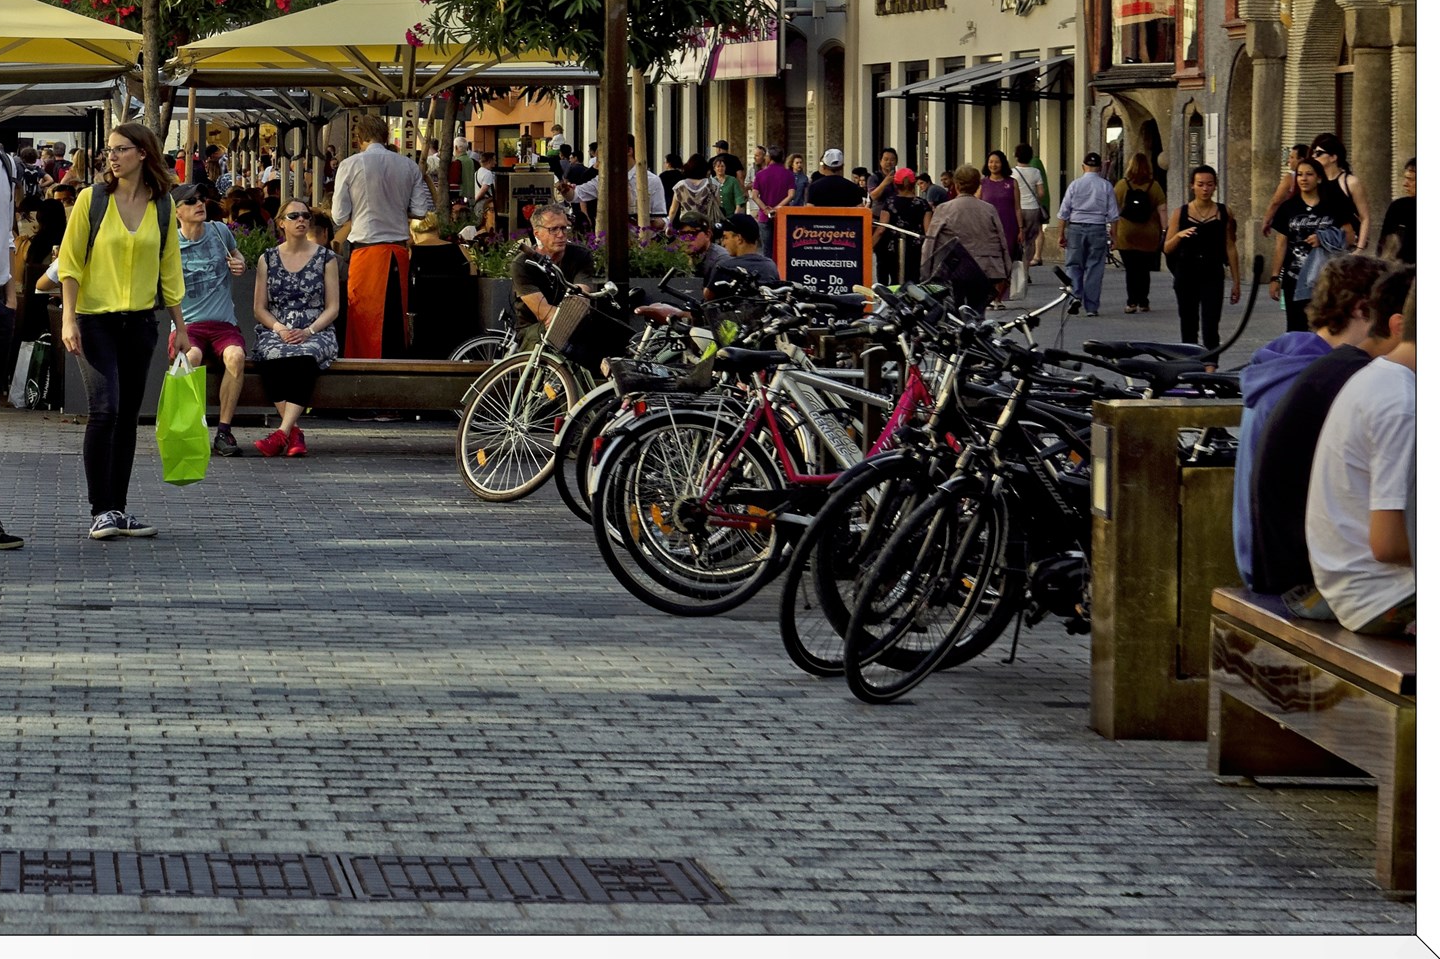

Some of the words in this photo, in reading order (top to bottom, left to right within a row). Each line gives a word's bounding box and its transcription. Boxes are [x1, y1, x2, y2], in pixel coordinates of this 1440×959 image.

[405, 110, 414, 149] CAFE
[792, 227, 856, 243] Orangerie
[791, 258, 857, 268] ÖFFNUNGSZEITEN
[804, 275, 817, 284] So
[829, 275, 843, 284] Do
[810, 411, 848, 456] GENESIS
[1026, 456, 1073, 514] Diamant
